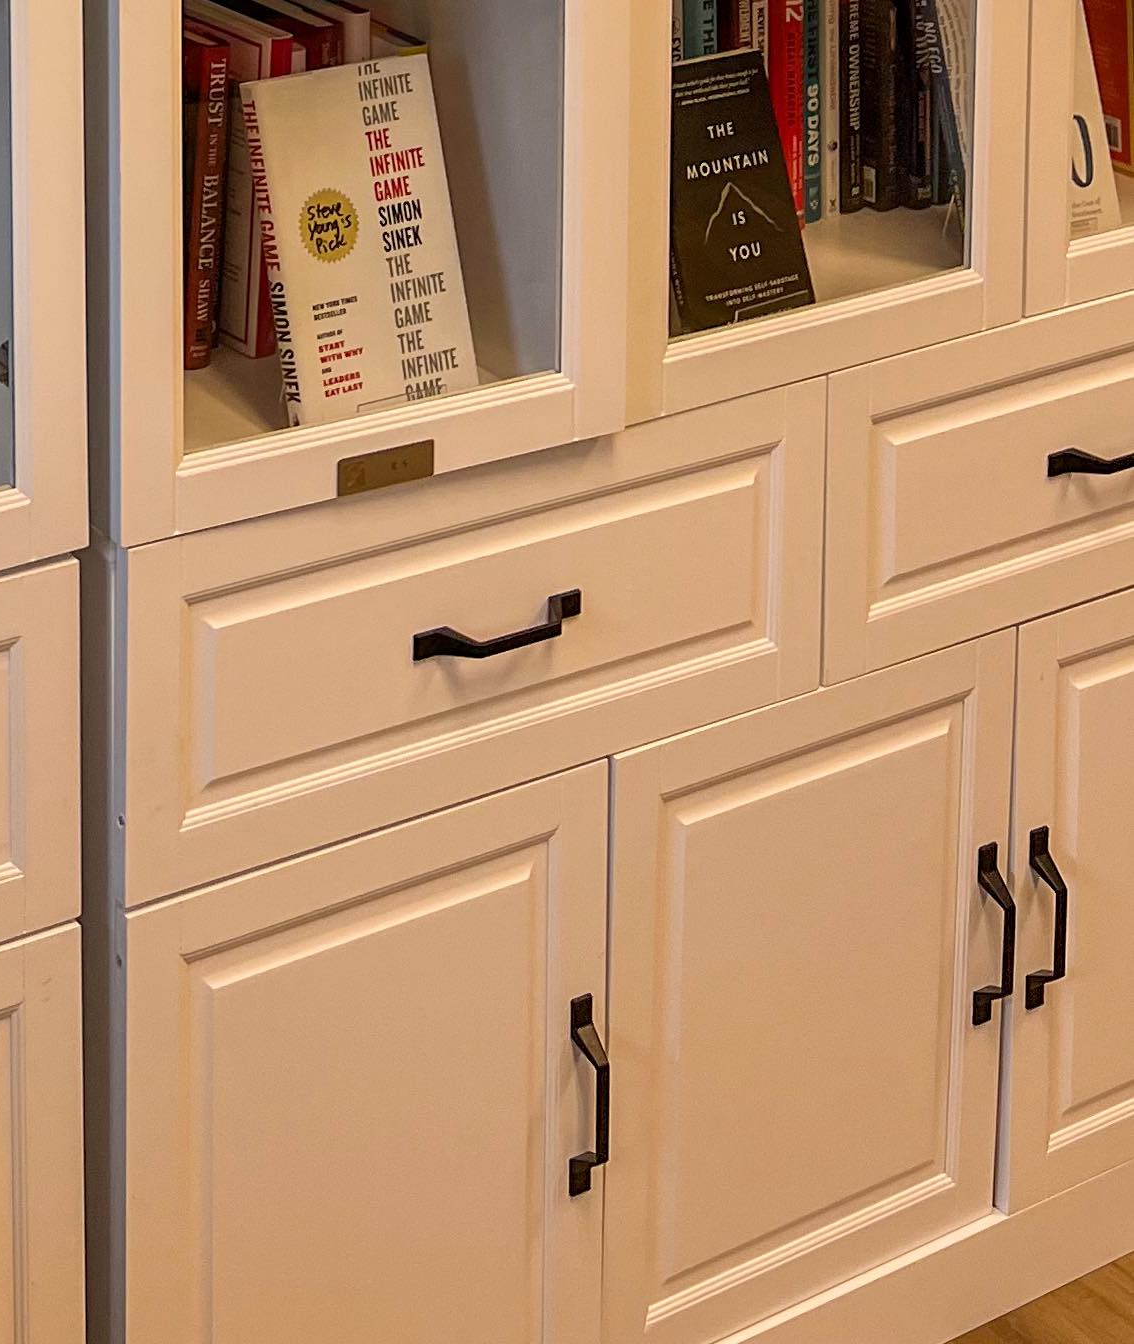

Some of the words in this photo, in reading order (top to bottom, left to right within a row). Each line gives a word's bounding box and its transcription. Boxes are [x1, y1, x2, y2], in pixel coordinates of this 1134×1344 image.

[358, 73, 413, 102] INFINITE
[362, 103, 400, 126] GAME
[365, 128, 391, 151] THE
[707, 121, 734, 139] THE
[369, 147, 425, 176] INFINITE
[686, 149, 768, 180] MOUNTAIN
[374, 176, 411, 201] GAME
[379, 199, 422, 227] SIMON
[732, 211, 746, 225] IS
[383, 227, 423, 252] SINEK
[729, 241, 760, 261] YOU
[386, 255, 413, 277] THE
[390, 273, 446, 303] INFINITE
[394, 303, 432, 328] GAME
